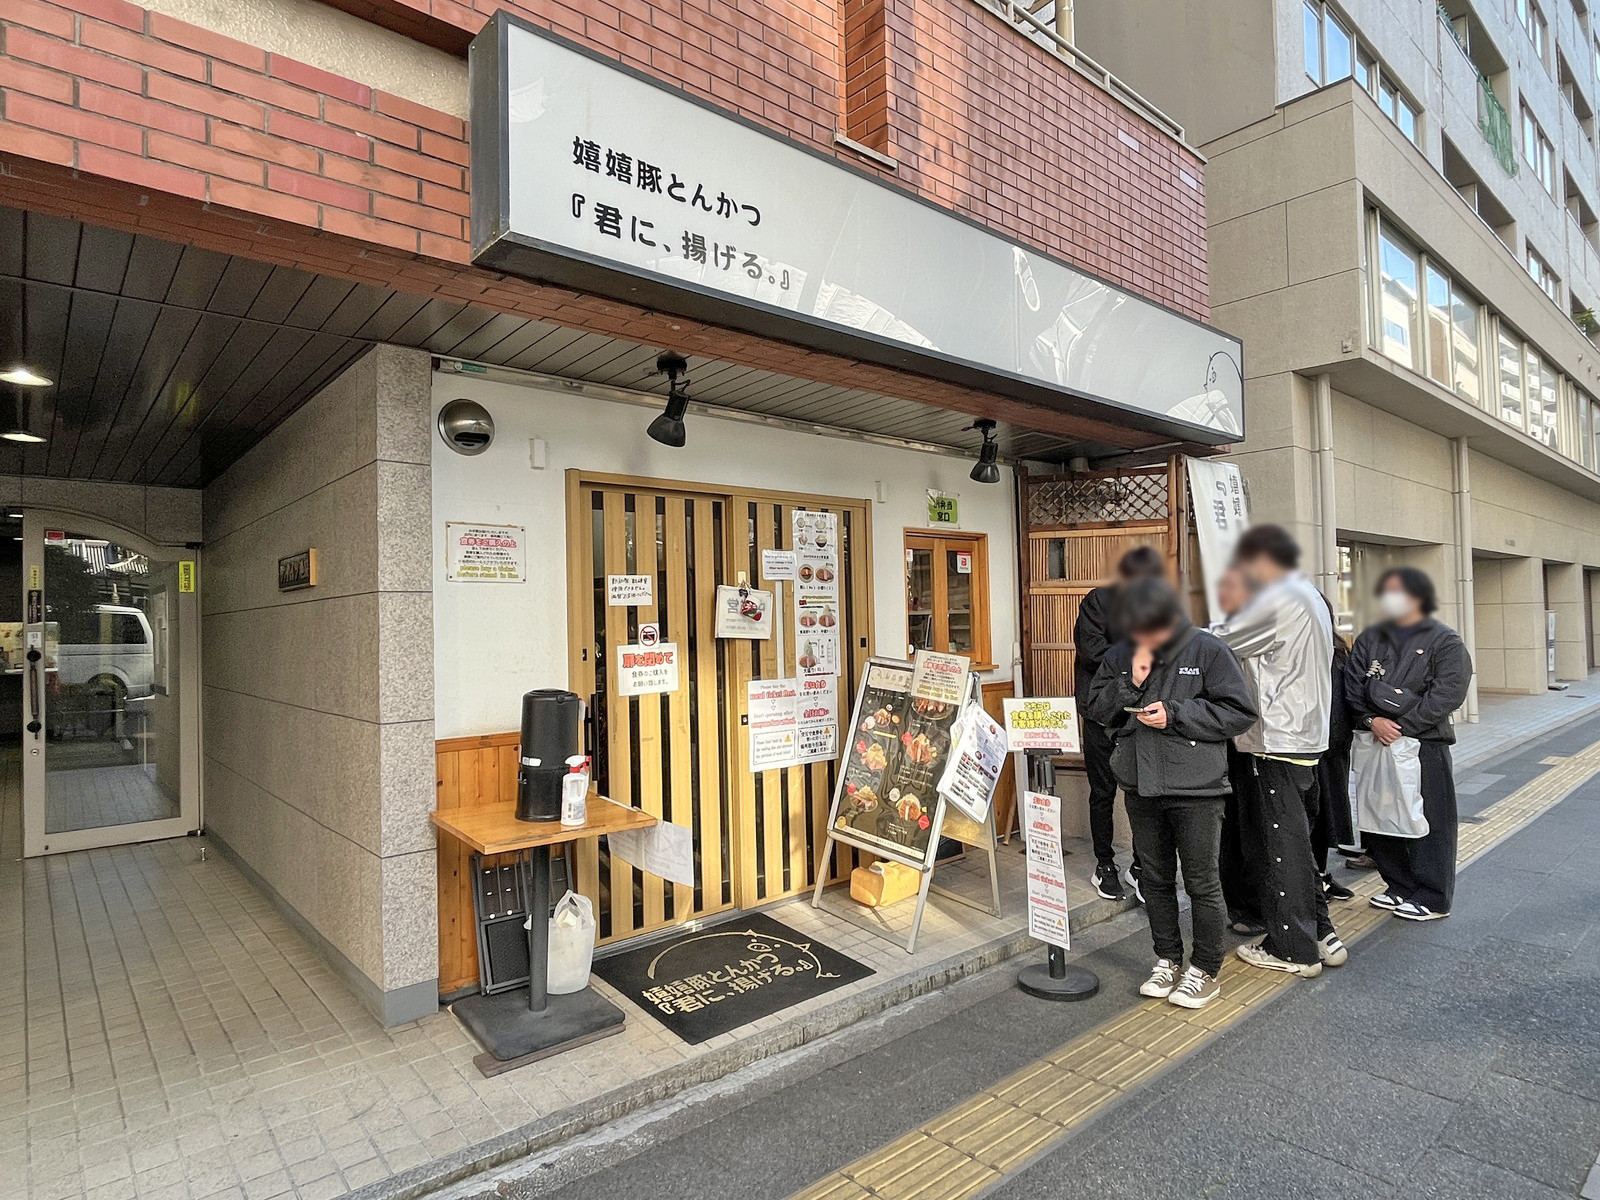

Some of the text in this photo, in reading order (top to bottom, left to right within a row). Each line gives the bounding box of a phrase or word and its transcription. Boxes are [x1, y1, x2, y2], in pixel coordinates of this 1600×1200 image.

[573, 135, 762, 227] 嬉嬉豚とんかつ
[571, 192, 790, 290] 『君に、揚げる。』
[622, 651, 674, 668] 扉を閉めて
[641, 952, 779, 1006] 嬉嬉豚とんかつ
